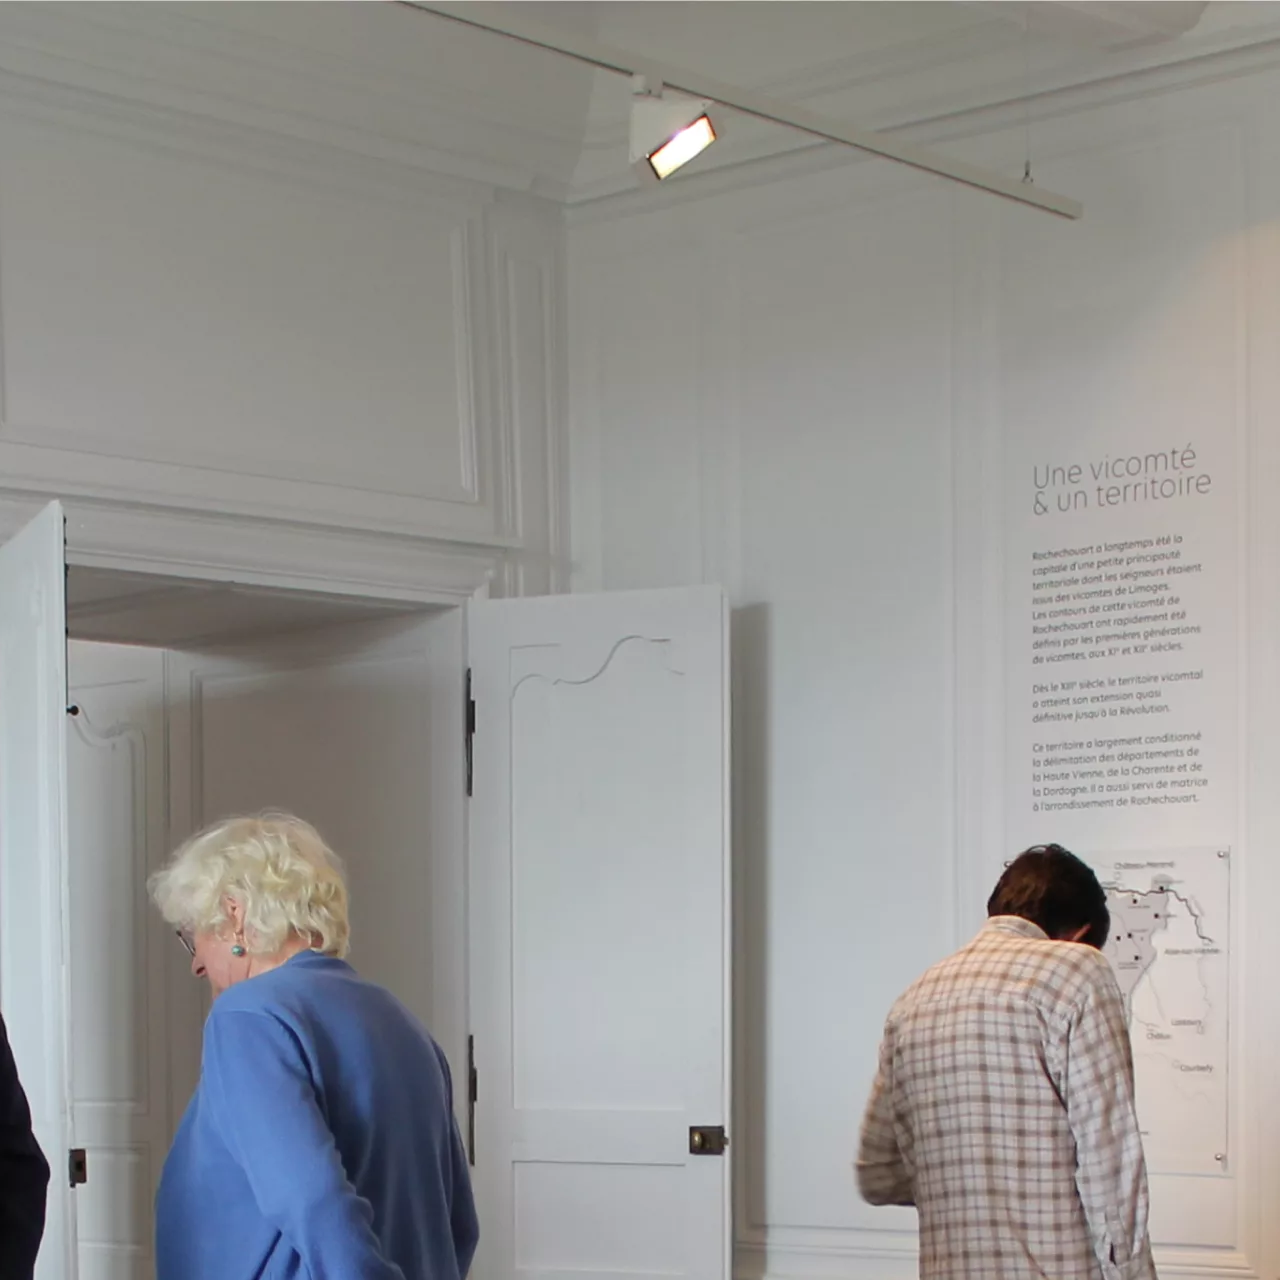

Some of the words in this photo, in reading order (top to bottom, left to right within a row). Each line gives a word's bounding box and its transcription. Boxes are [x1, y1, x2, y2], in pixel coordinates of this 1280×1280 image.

[1033, 463, 1083, 490] Une
[1090, 442, 1197, 480] vicomté
[1033, 491, 1049, 516] &
[1057, 489, 1088, 512] un
[1097, 471, 1212, 507] territoire
